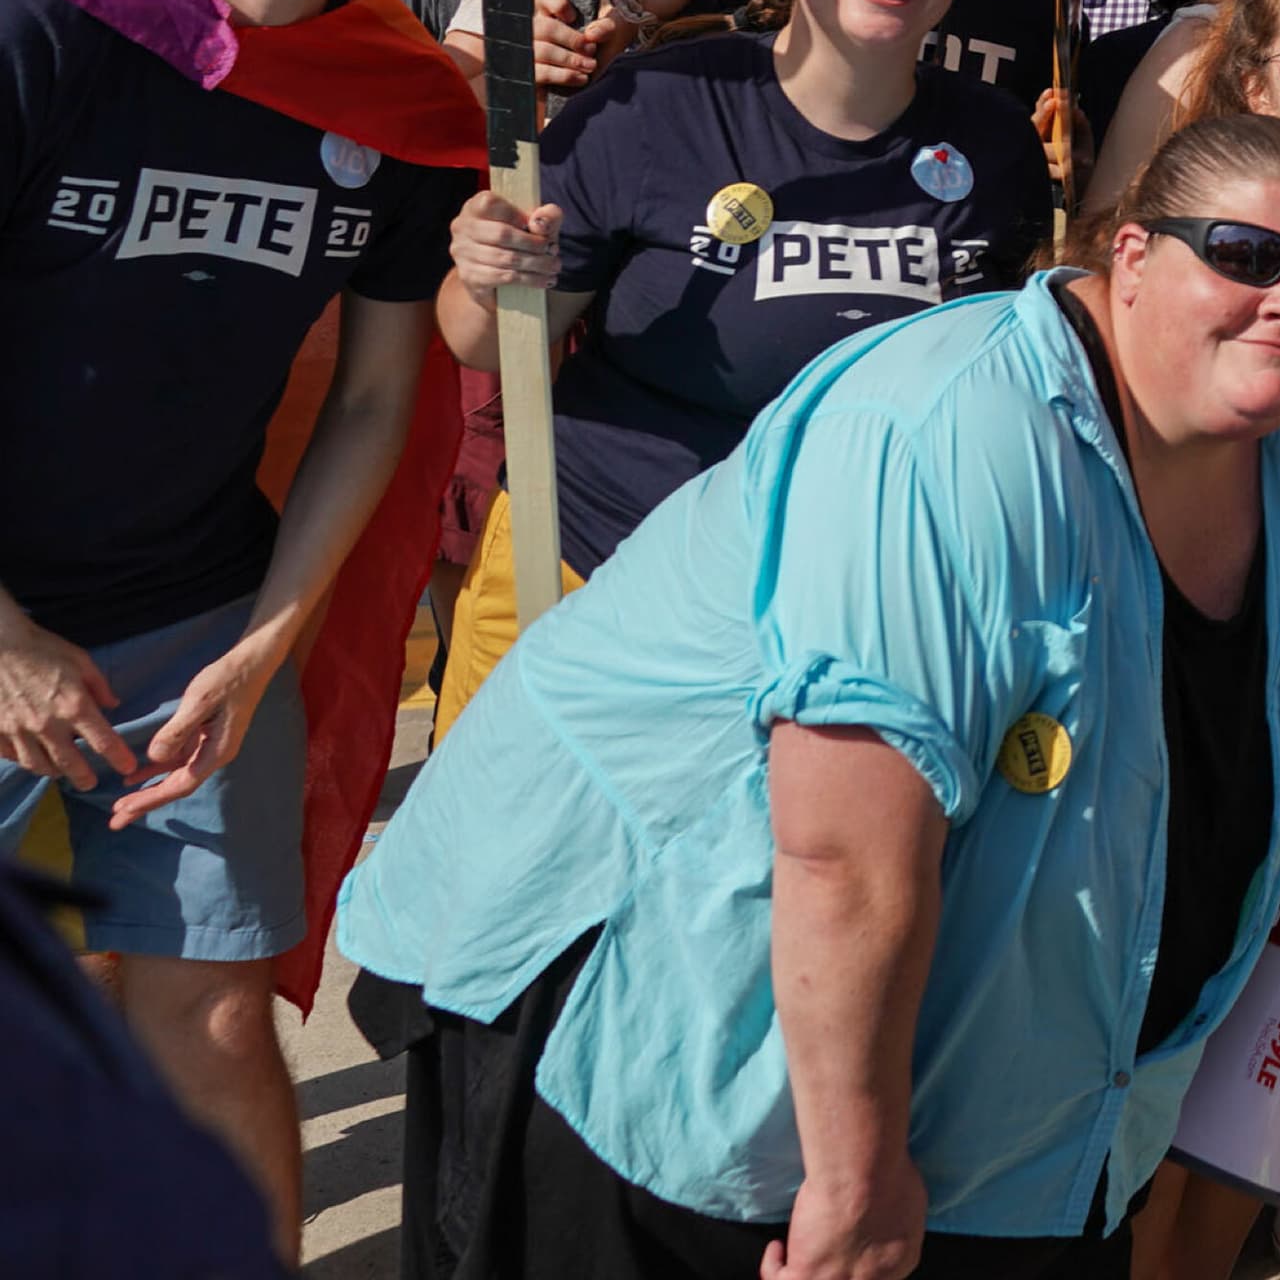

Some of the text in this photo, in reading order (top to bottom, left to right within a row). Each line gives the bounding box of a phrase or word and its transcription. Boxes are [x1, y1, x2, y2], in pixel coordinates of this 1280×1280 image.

[51, 184, 370, 256] 20 PETE 20
[690, 233, 928, 286] 20 PETE
